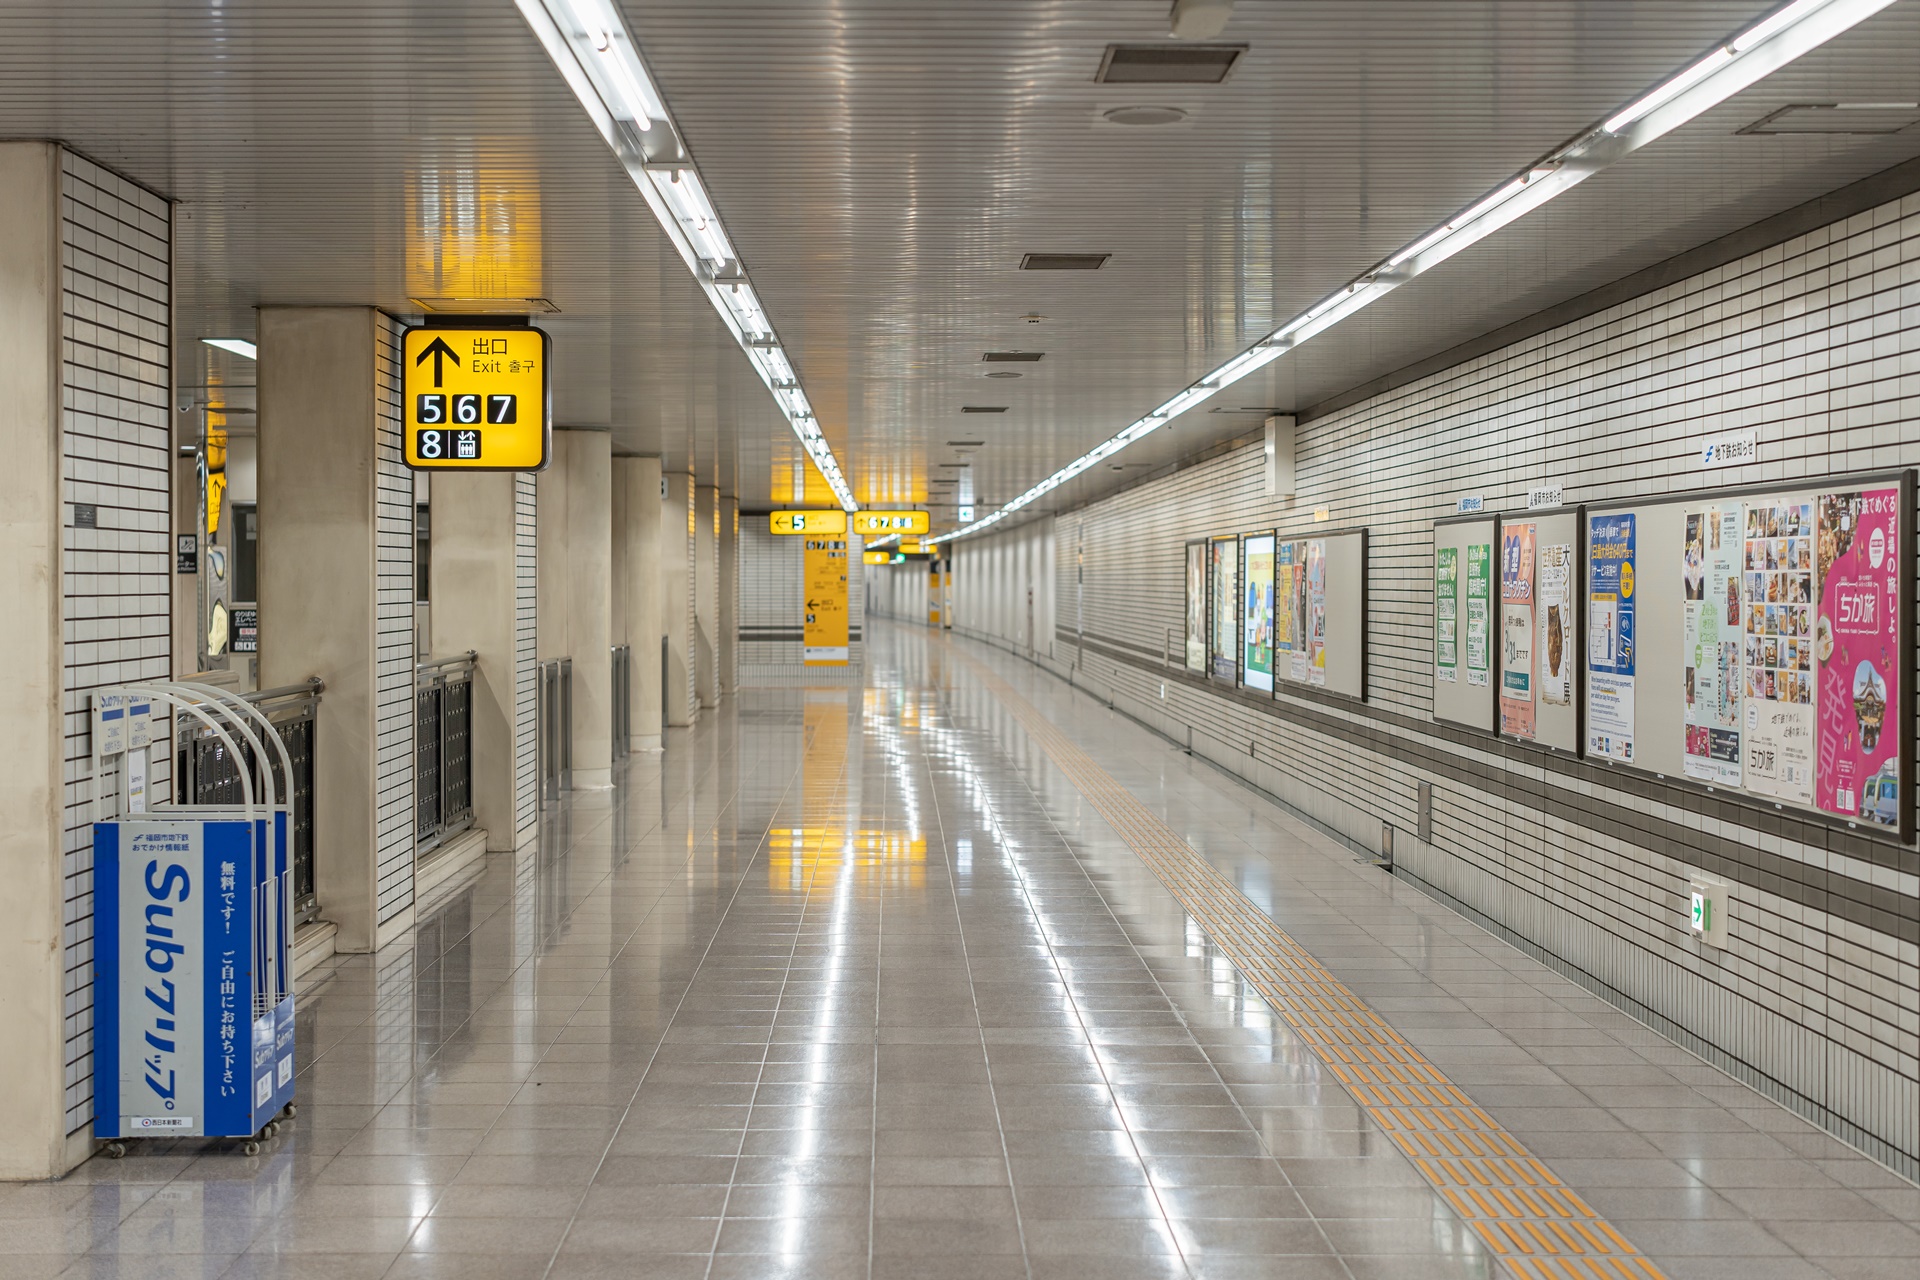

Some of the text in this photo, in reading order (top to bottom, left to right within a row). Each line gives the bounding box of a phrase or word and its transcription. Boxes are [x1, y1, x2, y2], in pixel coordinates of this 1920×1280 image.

[473, 337, 507, 355] 出口
[473, 359, 535, 373] Exit 출구
[423, 395, 512, 423] 5 6 7
[421, 430, 442, 458] 8
[1715, 440, 1754, 460] 地下鉄お知らせ
[1849, 496, 1896, 516] 地下鉄でめぐる
[793, 514, 806, 531] 5
[1504, 546, 1520, 574] 新型
[1503, 579, 1531, 600] コロナワクチン
[1839, 593, 1876, 623] ちか旅
[1562, 545, 1571, 703] 大シルクロード展
[1751, 749, 1775, 771] ちか旅
[132, 843, 190, 852] おでかけ情報紙
[145, 833, 189, 842] 福岡市地下鉄
[220, 861, 236, 1097] 無料です! ご自由にお持ち下さい
